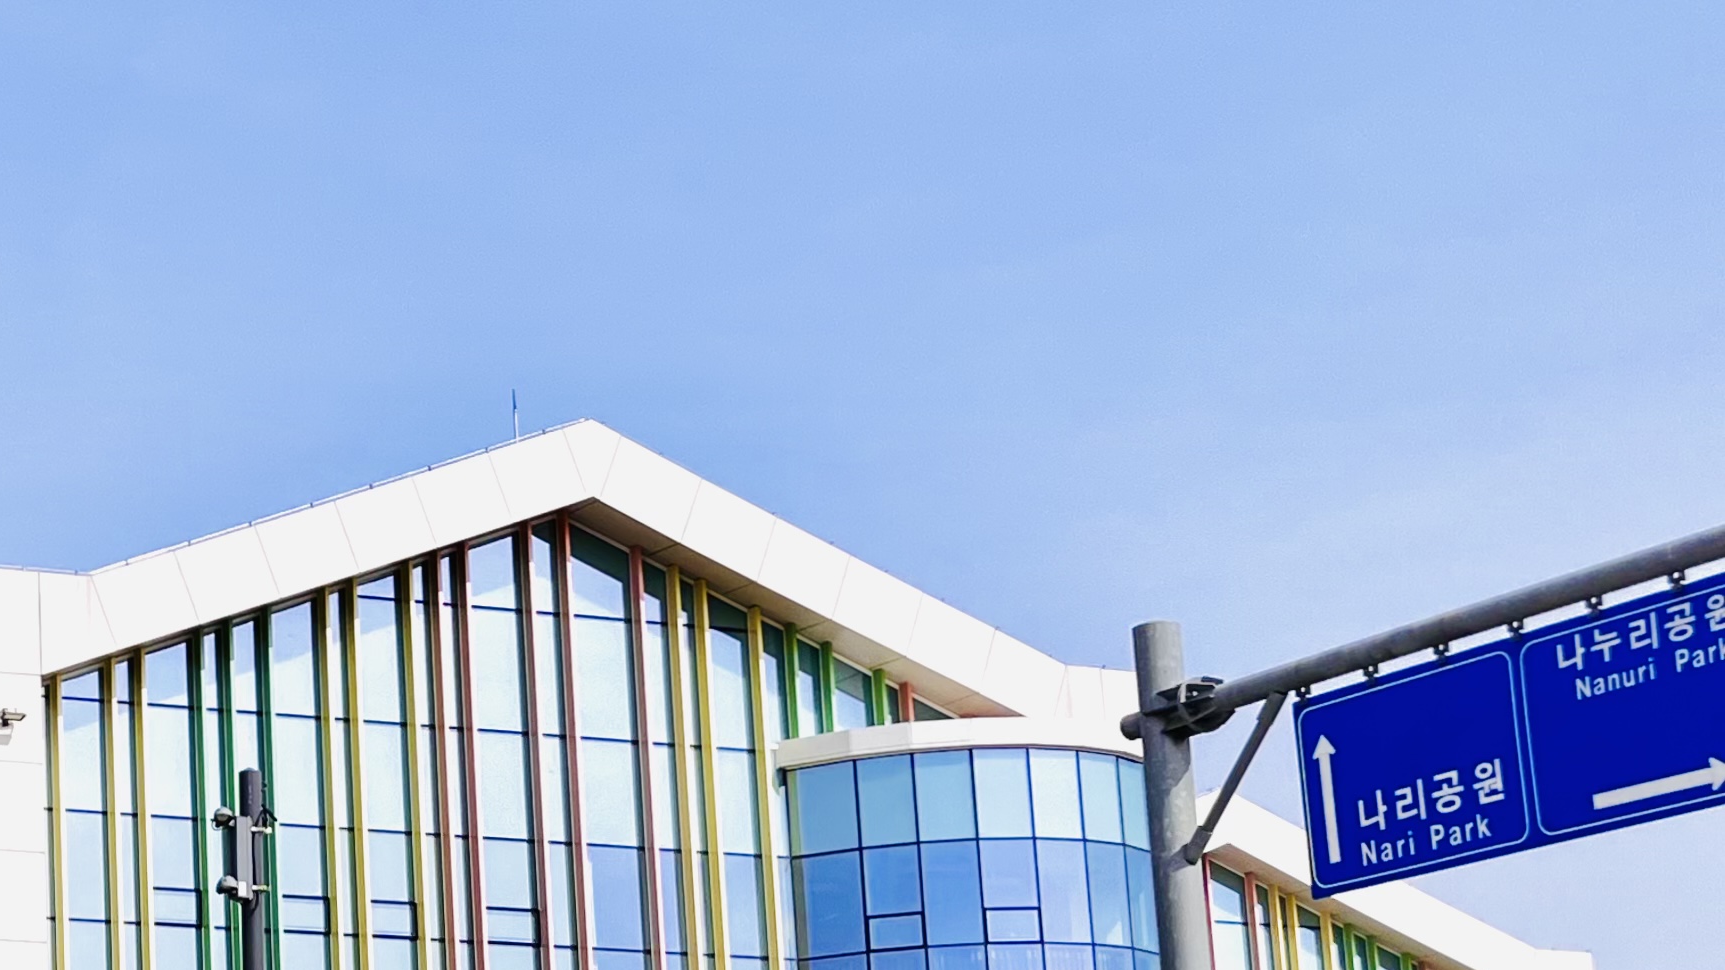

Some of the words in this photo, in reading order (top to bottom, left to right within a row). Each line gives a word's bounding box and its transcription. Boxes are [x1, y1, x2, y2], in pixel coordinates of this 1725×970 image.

[1575, 657, 1657, 700] Nanuri
[1358, 758, 1505, 830] 나리공원
[1360, 830, 1415, 866] Nari
[1430, 813, 1492, 850] Park
